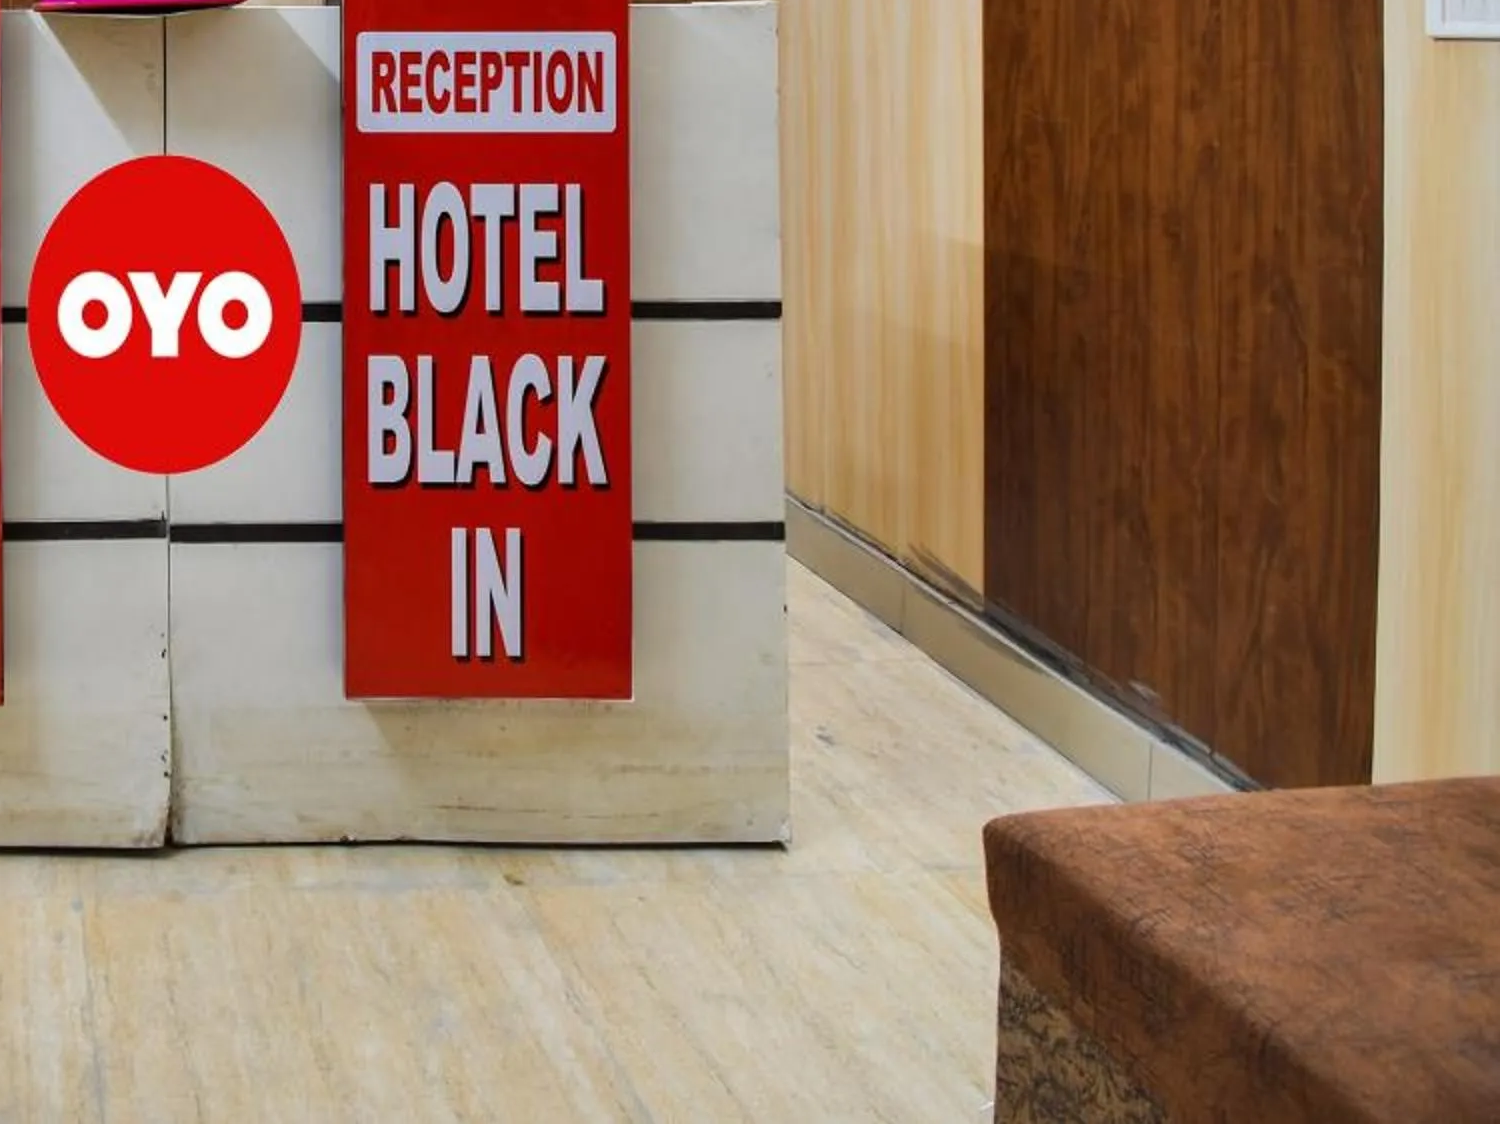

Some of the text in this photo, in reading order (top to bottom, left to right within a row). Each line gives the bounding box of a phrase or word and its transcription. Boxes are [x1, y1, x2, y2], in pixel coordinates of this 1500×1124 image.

[372, 51, 604, 114] RECEPTION
[371, 182, 602, 312] HOTEL
[58, 272, 272, 358] OYO
[369, 354, 606, 484] BLACK
[452, 528, 520, 656] IN
